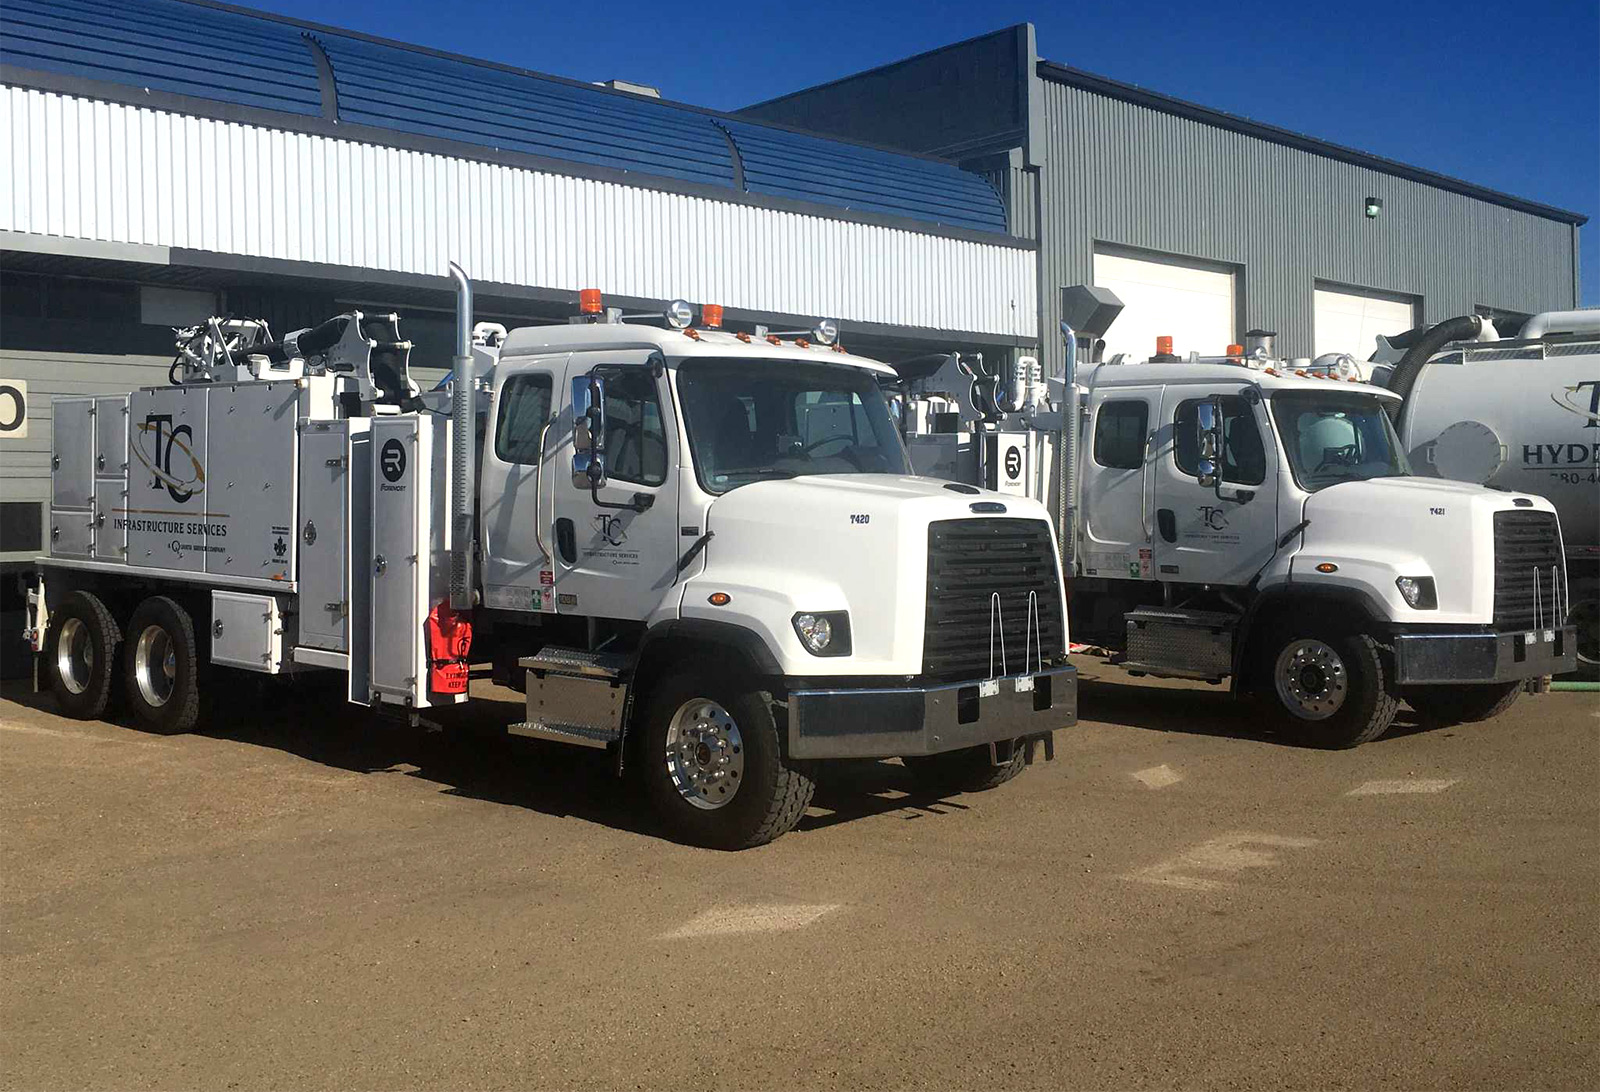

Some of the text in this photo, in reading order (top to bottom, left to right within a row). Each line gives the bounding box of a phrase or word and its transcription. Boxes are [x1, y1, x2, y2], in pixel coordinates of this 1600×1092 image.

[145, 414, 193, 503] TC
[114, 518, 227, 537] INFRASTRUCTURE SERVICES
[598, 514, 621, 546] TC
[850, 515, 870, 524] T420
[1200, 506, 1224, 531] TC
